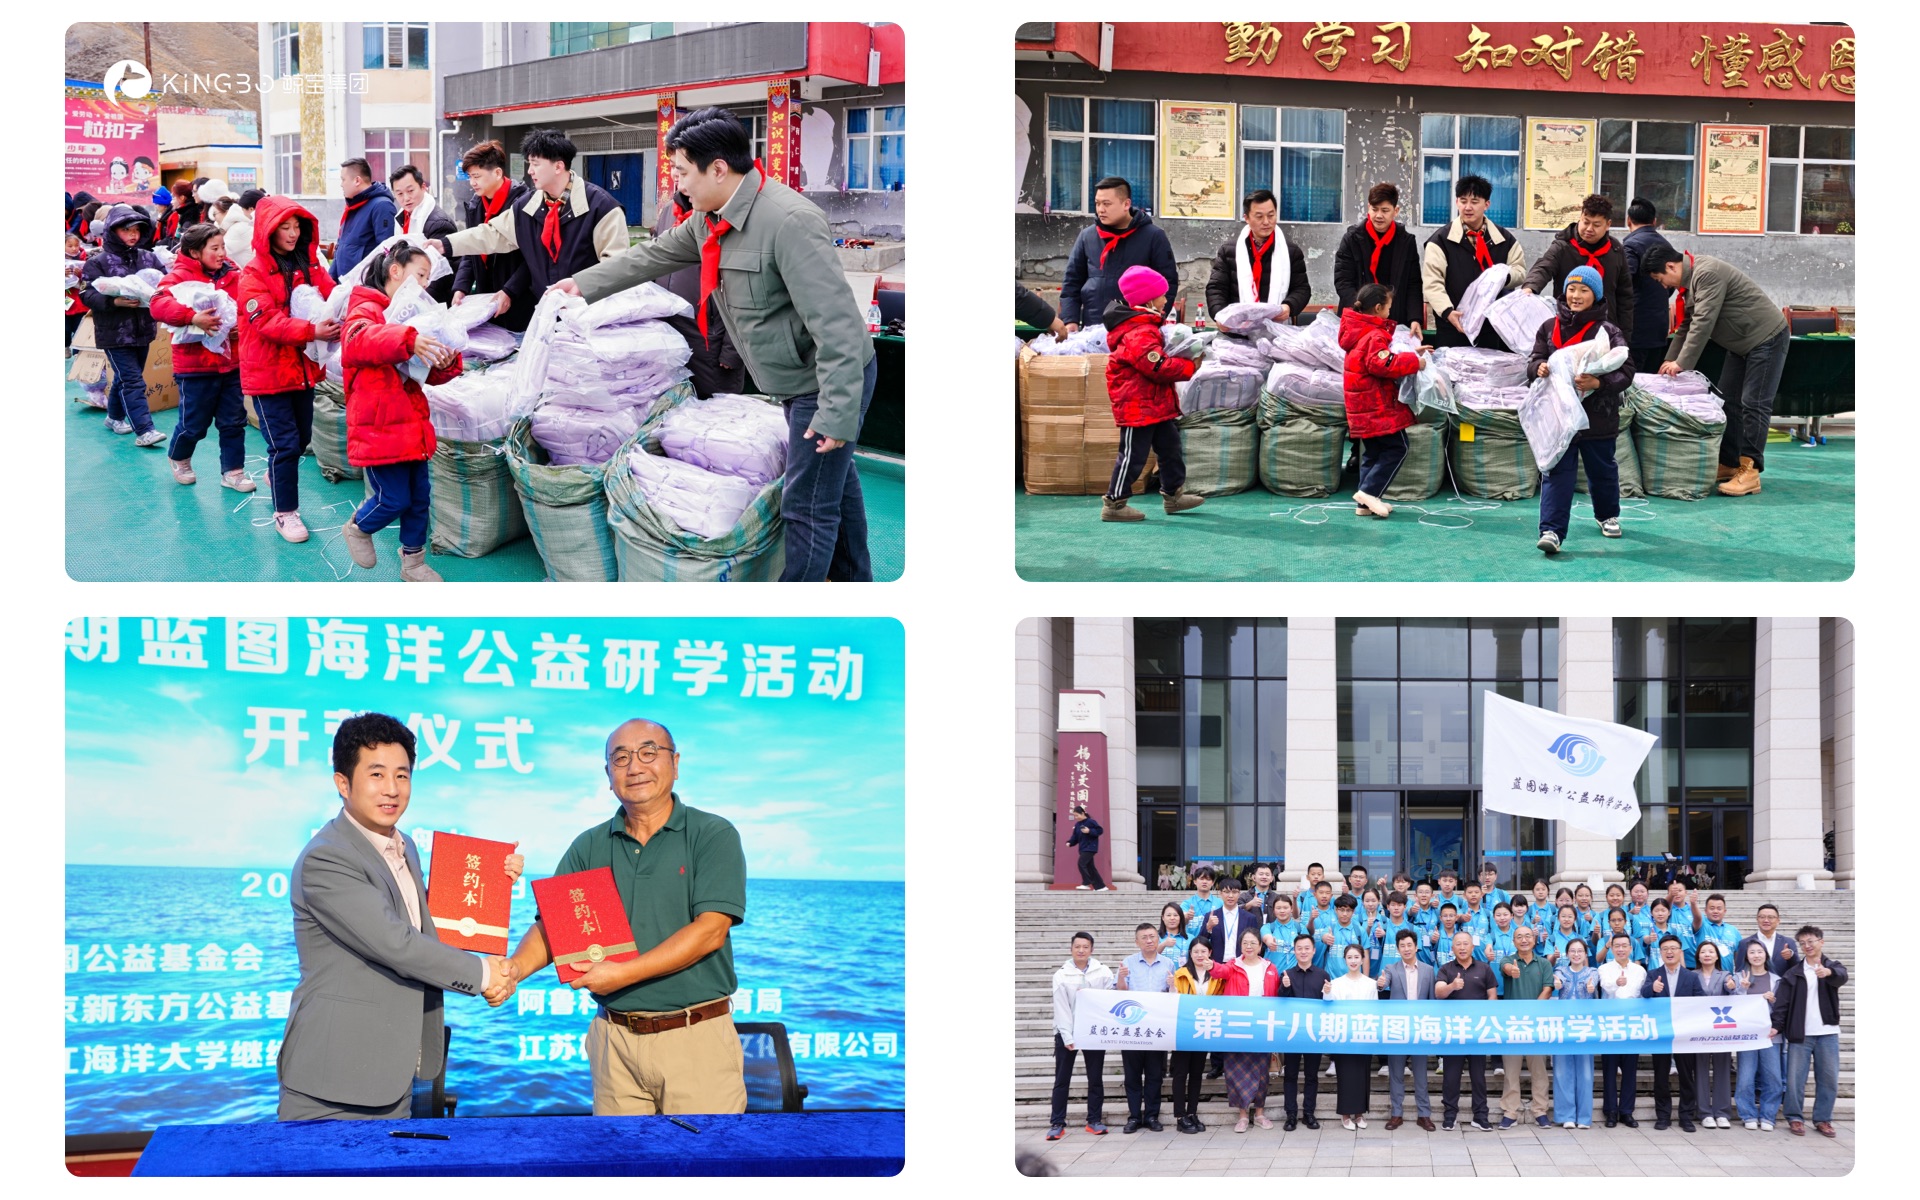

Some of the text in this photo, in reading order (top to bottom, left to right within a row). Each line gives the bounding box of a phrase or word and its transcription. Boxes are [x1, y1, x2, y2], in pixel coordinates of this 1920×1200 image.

[1223, 22, 1855, 95] 勤学习 知对错 懂感恩
[65, 120, 145, 140] 一粒扣子
[65, 157, 106, 165] 任的时代新人
[65, 617, 864, 701] 期蓝图海洋公益研学活动
[461, 853, 482, 907] 签约本
[568, 887, 597, 936] 签约本
[1192, 1006, 1659, 1045] 第三十八期蓝图海洋公益研学活动
